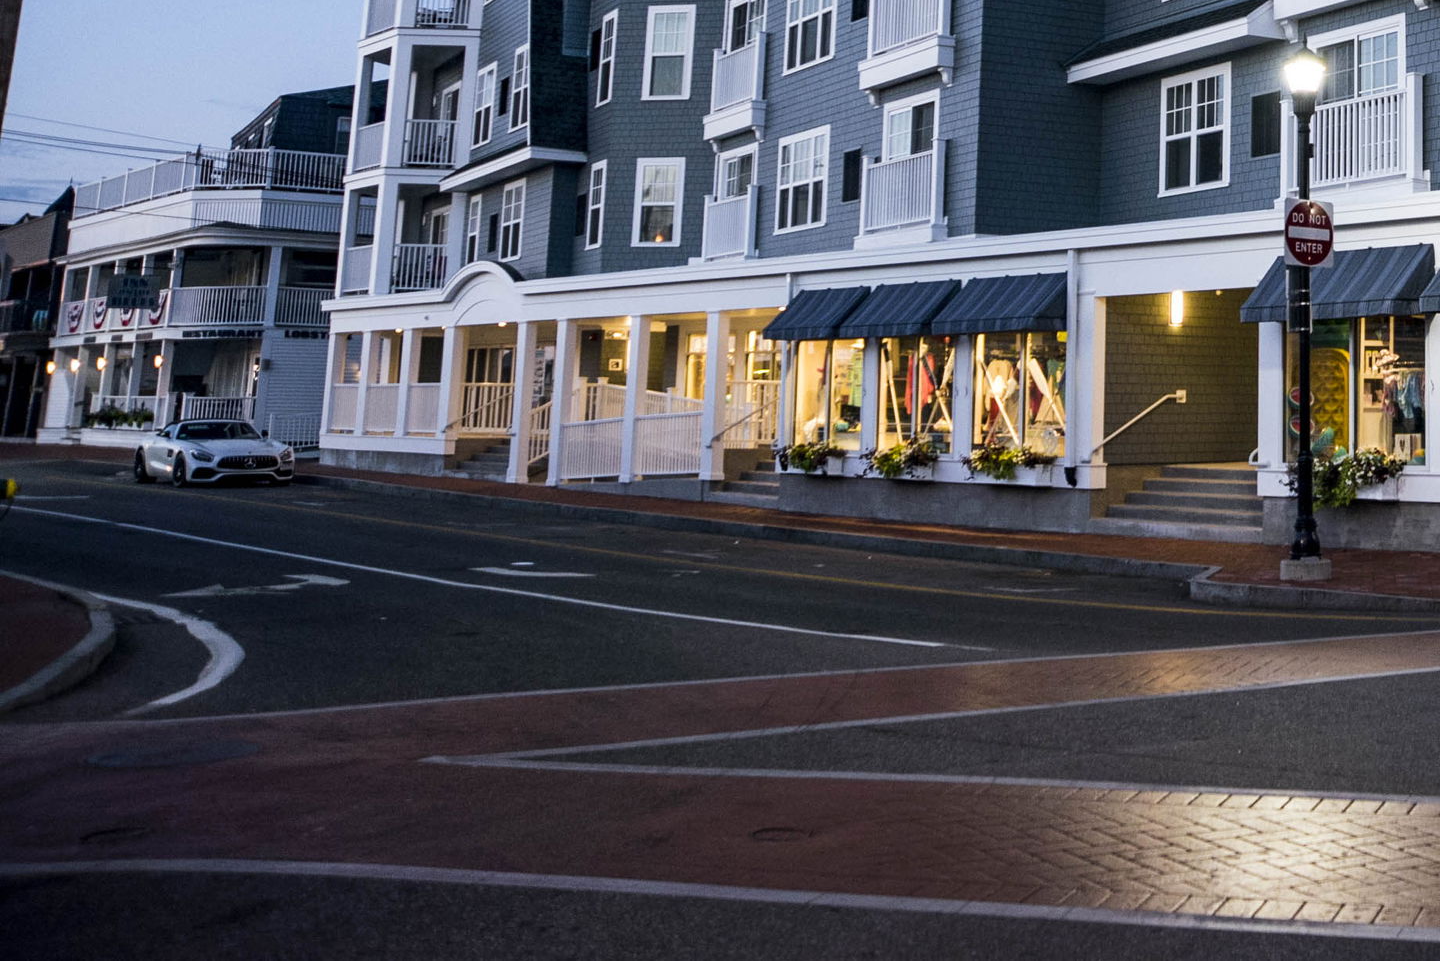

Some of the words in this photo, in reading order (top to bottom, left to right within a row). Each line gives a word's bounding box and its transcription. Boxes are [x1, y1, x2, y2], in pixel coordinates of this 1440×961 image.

[1292, 212, 1304, 223] DO
[1309, 214, 1326, 225] NOT
[1295, 241, 1323, 254] ENTER
